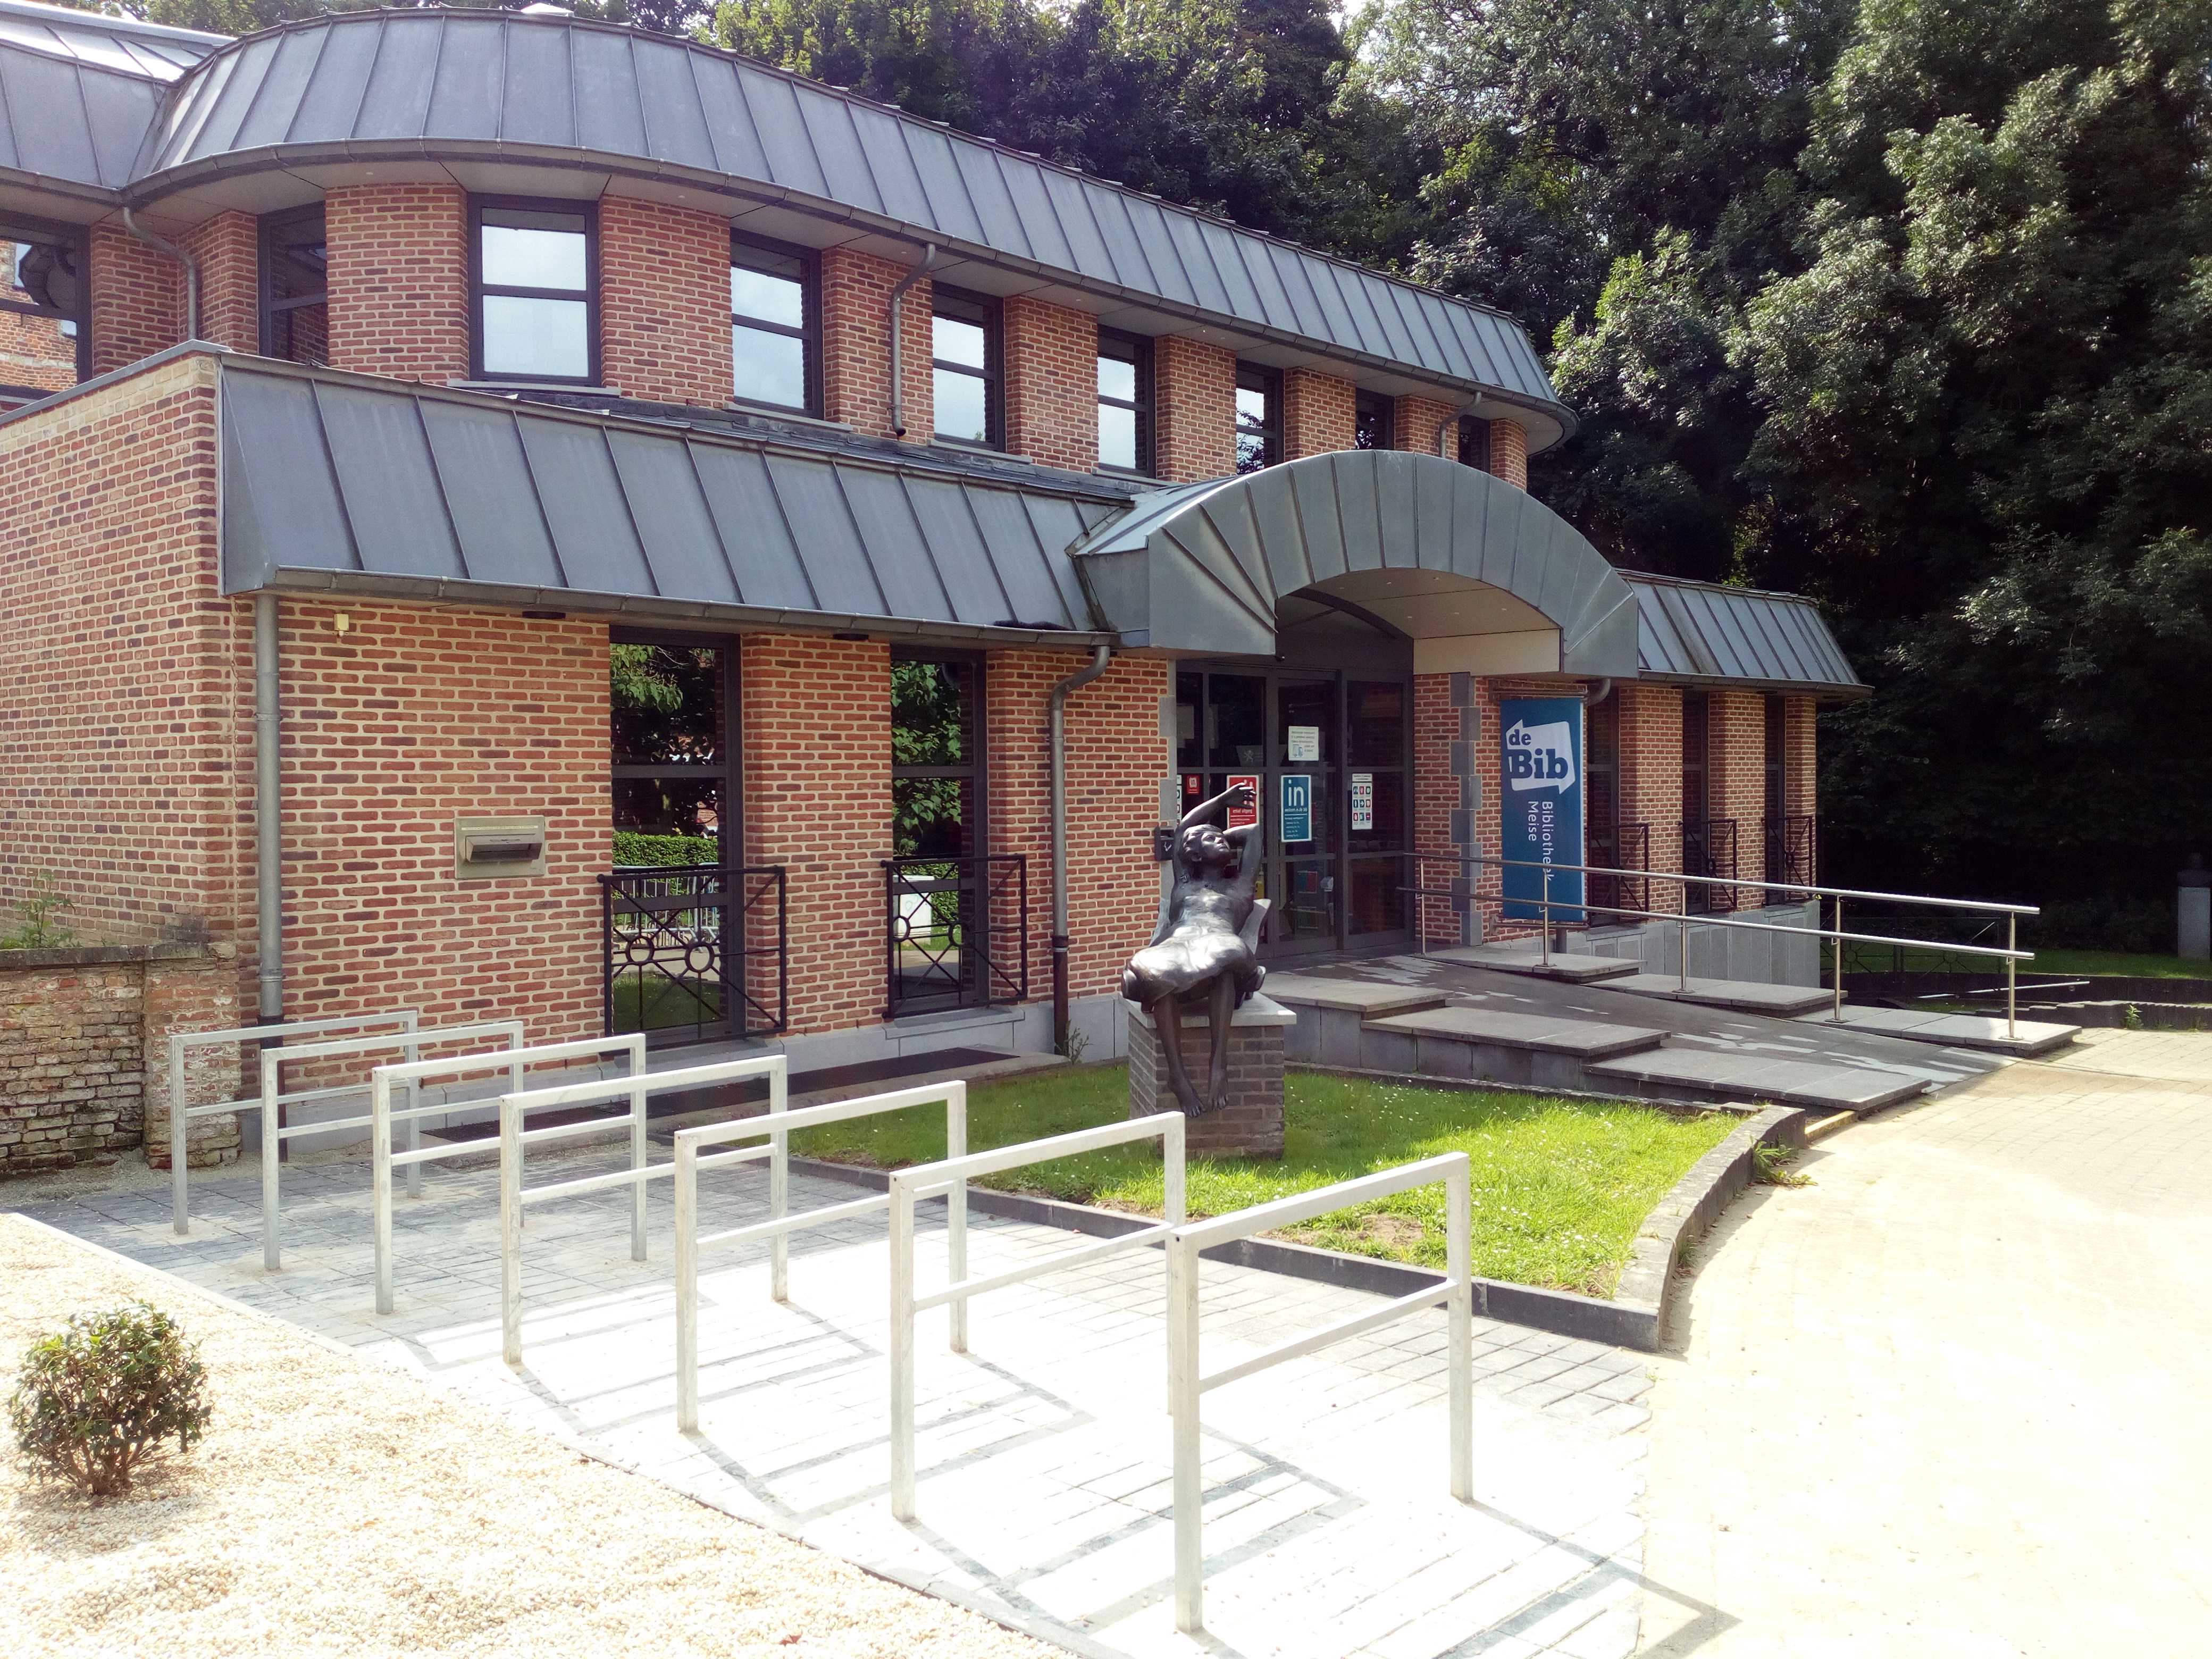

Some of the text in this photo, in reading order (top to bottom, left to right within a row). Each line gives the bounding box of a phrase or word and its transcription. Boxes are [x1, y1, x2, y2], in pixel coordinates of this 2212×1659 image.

[1509, 729, 1531, 745] de
[1509, 748, 1569, 779] Bib
[1288, 779, 1304, 806] in
[1528, 801, 1539, 841] Meise
